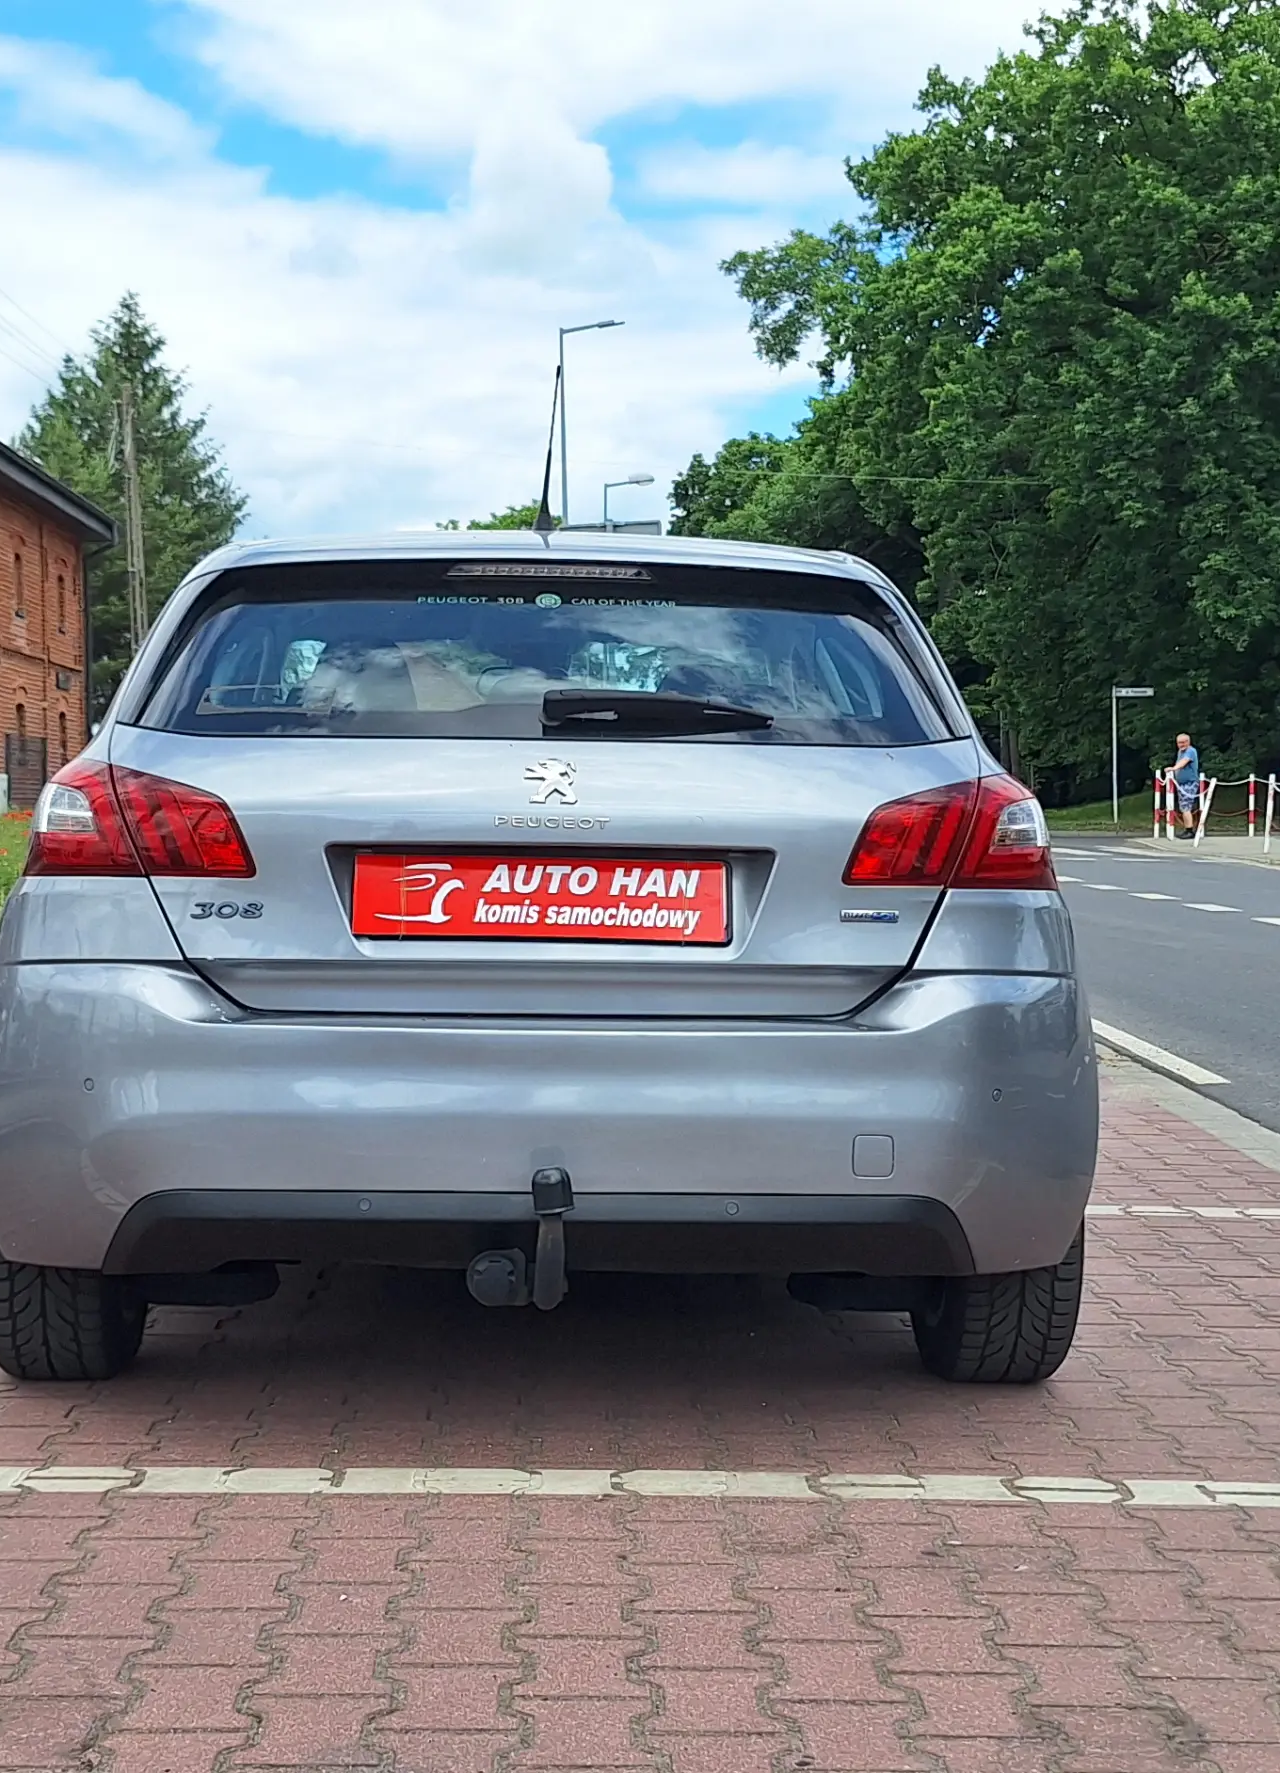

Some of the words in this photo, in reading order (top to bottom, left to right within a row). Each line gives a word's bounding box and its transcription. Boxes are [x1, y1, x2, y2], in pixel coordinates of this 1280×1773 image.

[416, 596, 489, 605] PEUGEOT
[496, 596, 525, 605] 308
[571, 598, 596, 606] CAR
[598, 598, 616, 606] OF
[618, 599, 643, 607] THE
[644, 600, 677, 608] YEAR
[493, 815, 610, 829] PEUGEOT
[480, 864, 599, 895] AUTO
[608, 867, 701, 898] HAN
[189, 901, 264, 919] 308
[473, 898, 539, 925] komis
[544, 901, 701, 935] samochodowy
